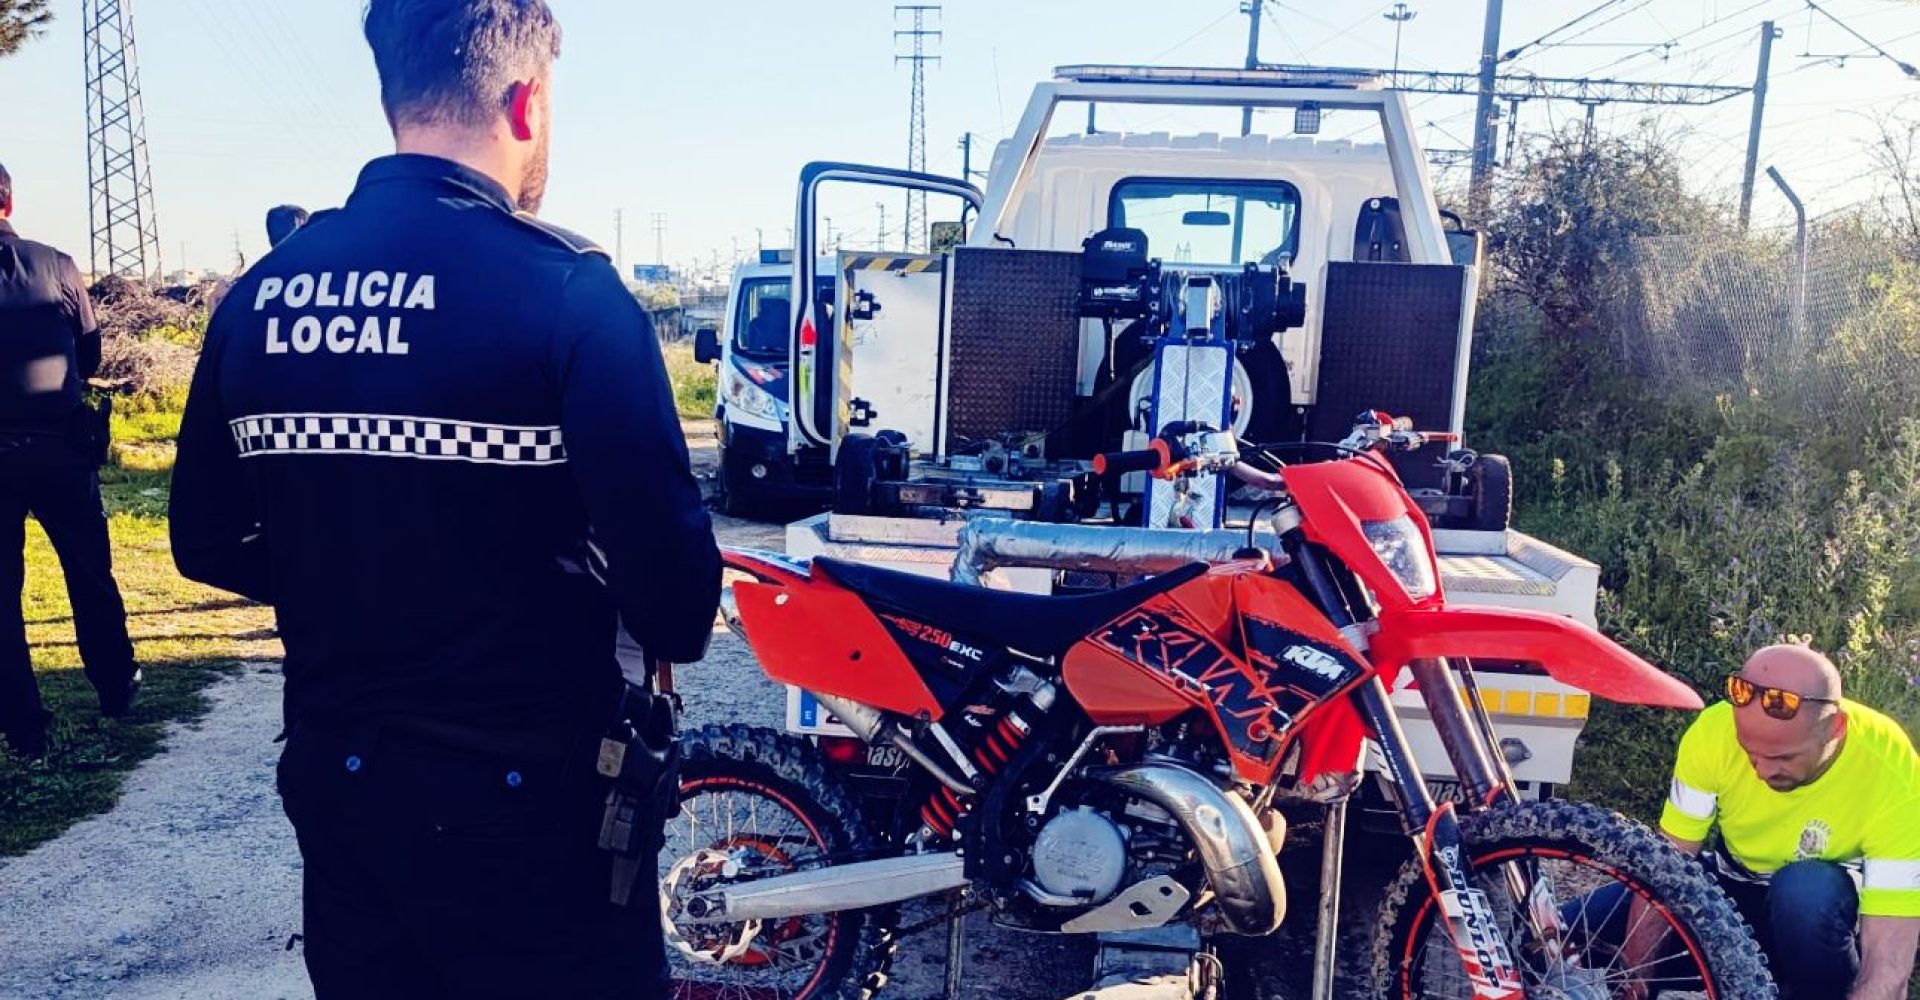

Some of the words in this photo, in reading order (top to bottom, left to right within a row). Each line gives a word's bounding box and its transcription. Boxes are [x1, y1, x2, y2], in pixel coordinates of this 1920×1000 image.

[253, 271, 436, 311] POLICIA
[265, 315, 410, 355] LOCAL
[1282, 644, 1347, 680] KTM
[1451, 870, 1500, 988] DUNLOP
